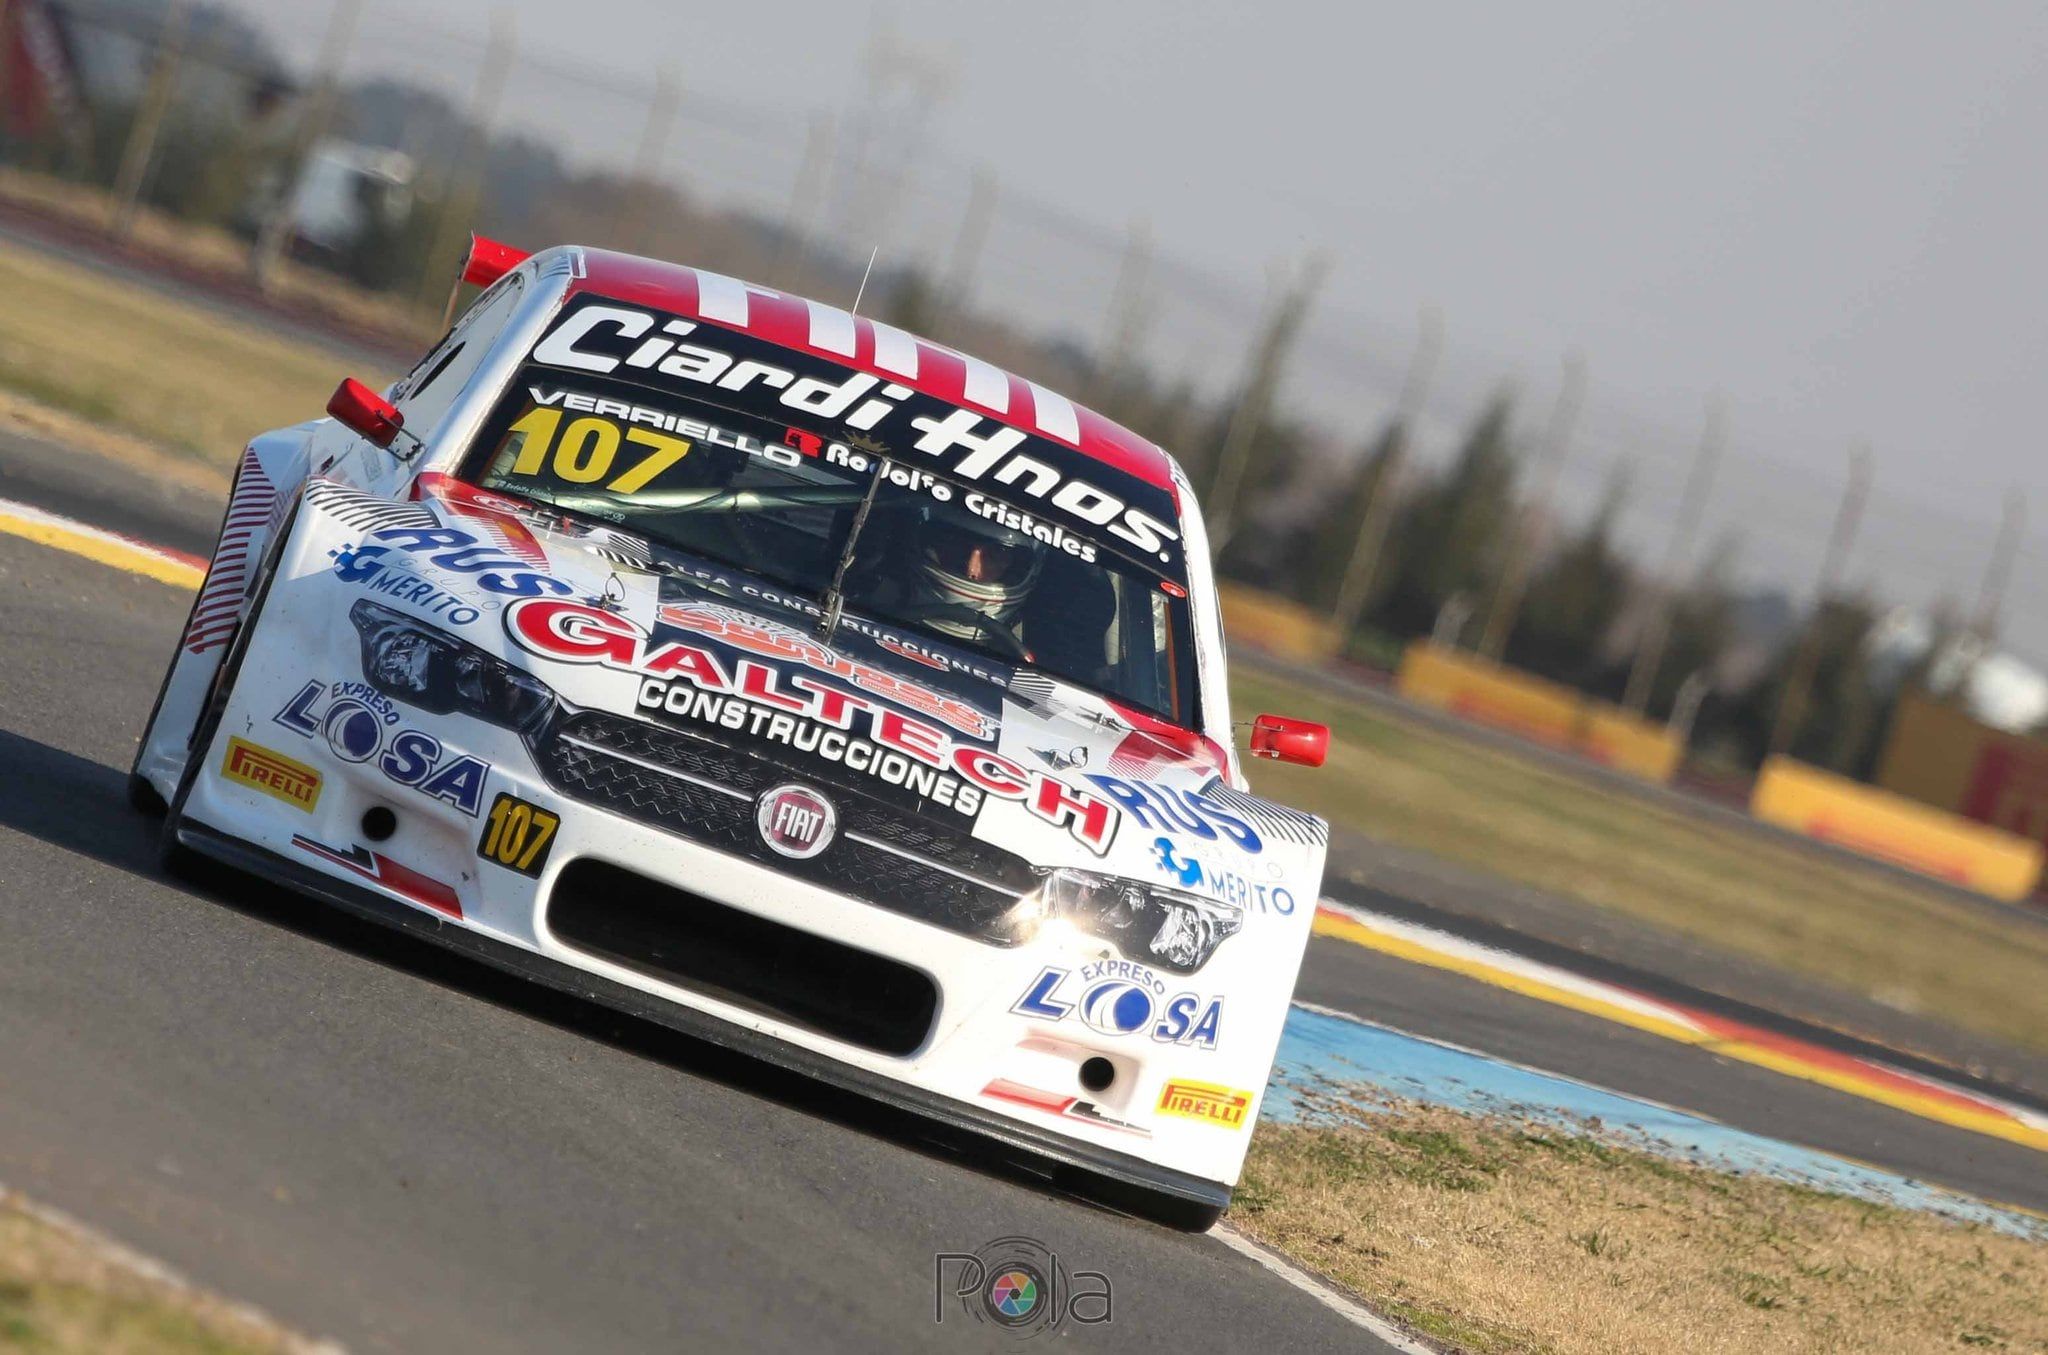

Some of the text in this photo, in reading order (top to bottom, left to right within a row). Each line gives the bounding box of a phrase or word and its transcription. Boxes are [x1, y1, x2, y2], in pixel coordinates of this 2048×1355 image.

[508, 408, 691, 495] 107
[528, 387, 801, 468] VERRIELLO
[533, 305, 1178, 563] Ciardi Hnos.
[826, 443, 952, 502] Rodolfo
[965, 494, 1096, 564] Cristales
[369, 569, 480, 626] MERITO
[371, 528, 573, 597] RUS
[331, 681, 400, 727] EXPRESO
[504, 598, 1121, 858] GALTECH
[229, 745, 319, 804] PIRELLI
[638, 678, 982, 817] CONSTRUCCIONES
[487, 797, 557, 871] 107
[774, 801, 823, 844] FIAT
[1083, 774, 1263, 854] RUS
[1207, 867, 1296, 916] MERITO
[1081, 959, 1166, 996] EXPRESO
[1160, 1084, 1246, 1124] PIRELLI
